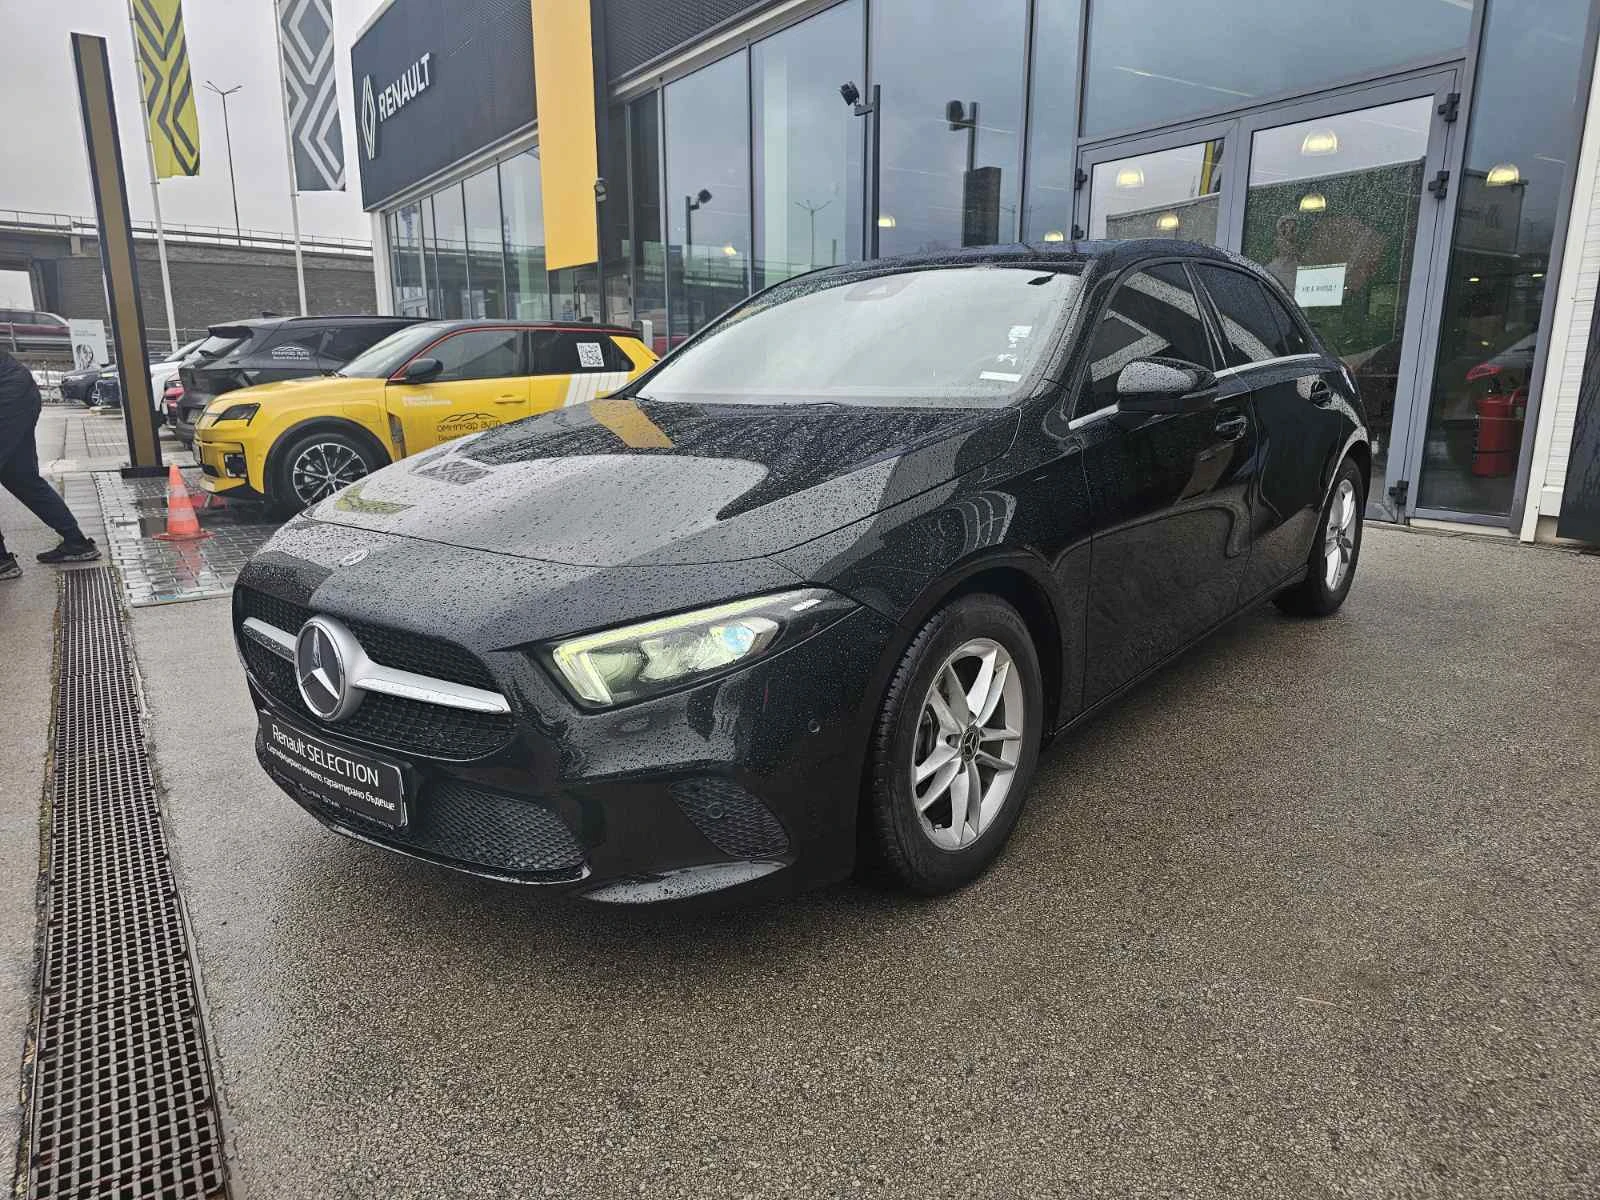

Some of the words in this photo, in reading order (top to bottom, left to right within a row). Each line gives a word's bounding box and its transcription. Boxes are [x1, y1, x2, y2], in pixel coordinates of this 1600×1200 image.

[378, 51, 430, 122] RENAULT
[272, 723, 306, 758] Renault
[306, 744, 379, 788] SELECTION
[323, 776, 365, 800] гарантирано
